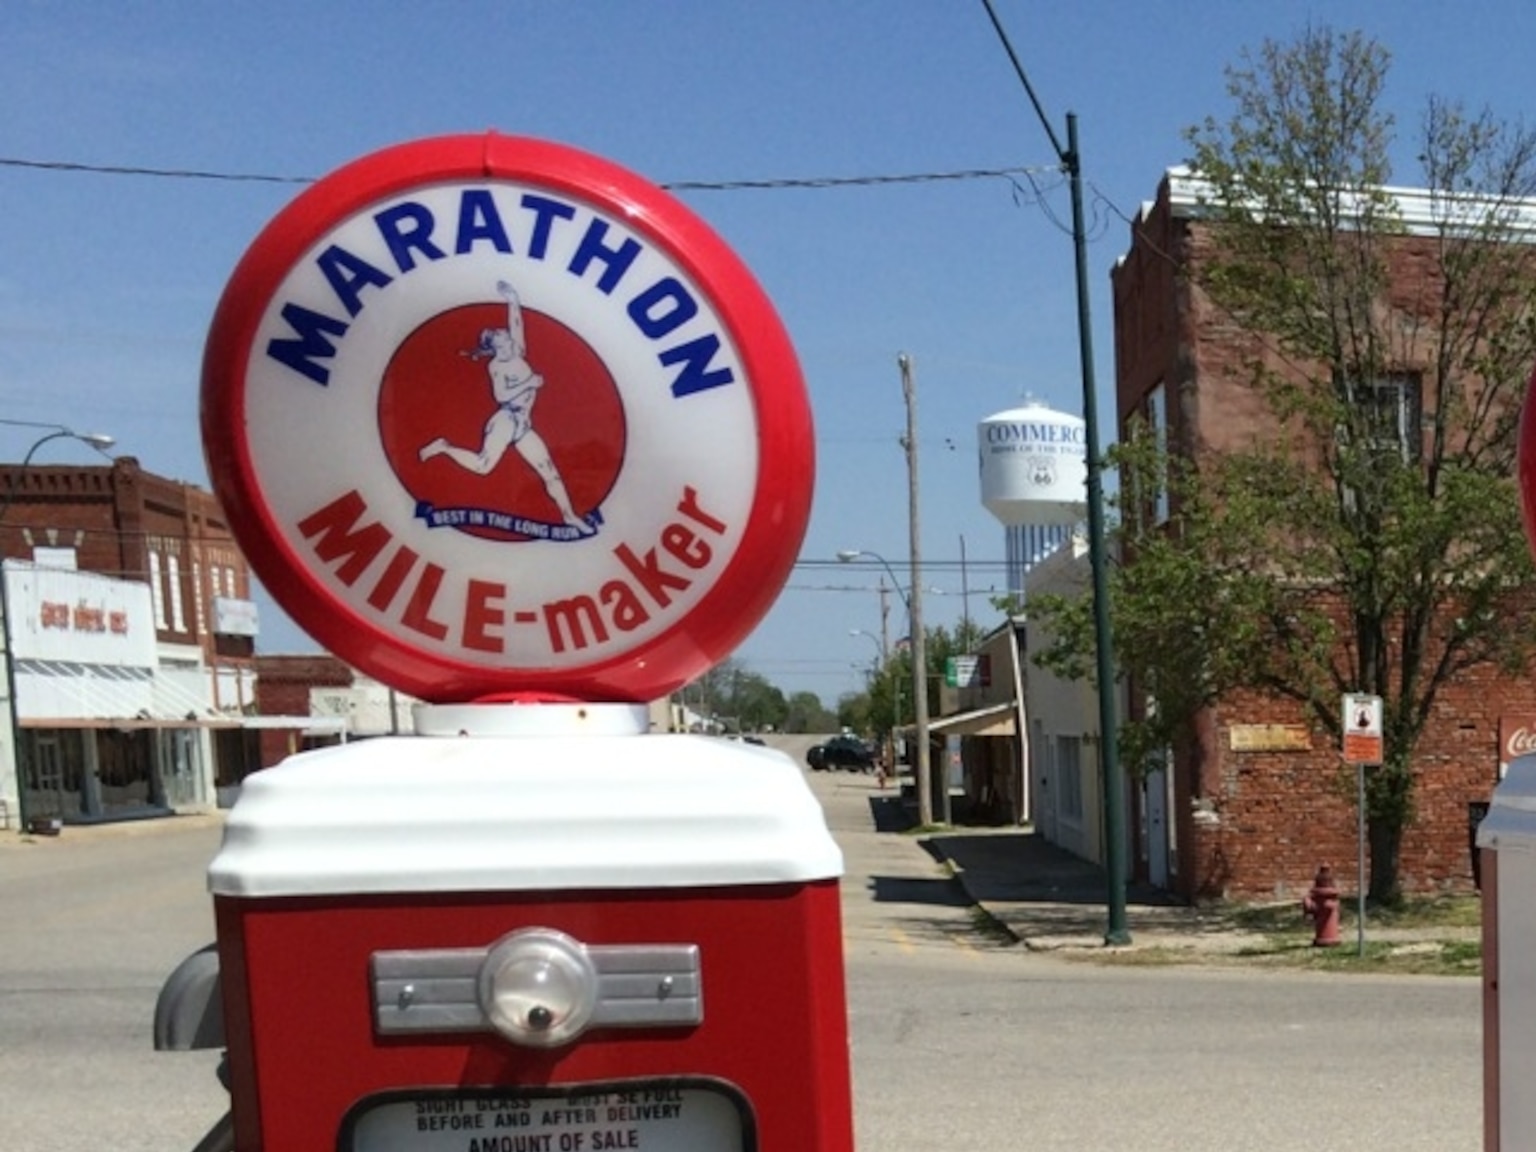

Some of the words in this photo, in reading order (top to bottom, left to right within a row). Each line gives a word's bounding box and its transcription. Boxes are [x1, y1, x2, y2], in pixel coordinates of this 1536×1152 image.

[266, 190, 734, 399] MARATHON
[988, 424, 1083, 444] COMMERC
[432, 510, 466, 525] BEST
[469, 511, 484, 525] IN
[487, 512, 512, 530] THE
[515, 520, 549, 538] LONG
[551, 526, 579, 539] RUN
[297, 484, 727, 654] MILE-maker
[417, 1114, 484, 1131] BEFORE
[495, 1111, 530, 1128] AND
[541, 1107, 596, 1126] AFTER
[606, 1103, 682, 1122] DELIVERY
[477, 1096, 532, 1112] GLASS
[560, 1132, 584, 1151] OF
[592, 1129, 639, 1150] SALE
